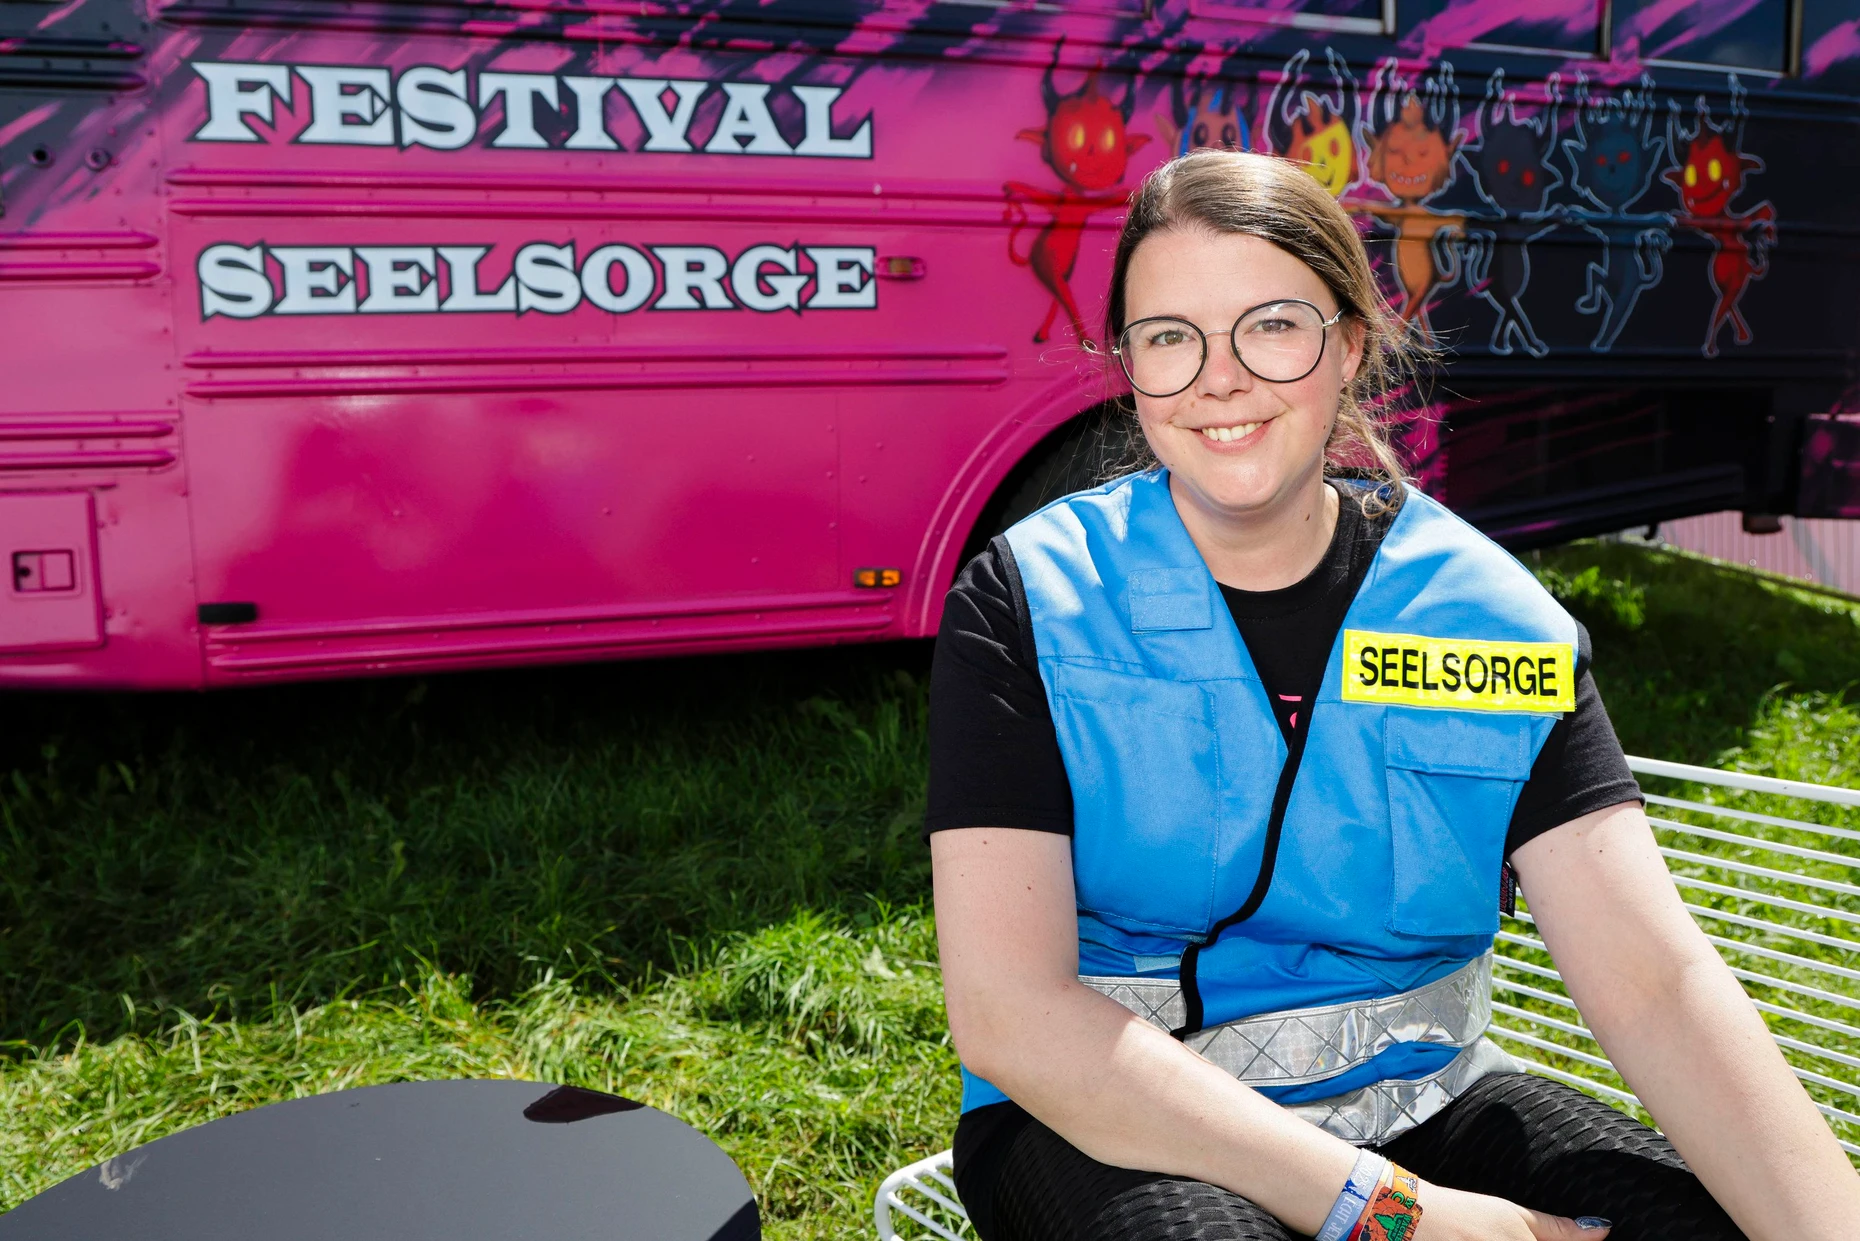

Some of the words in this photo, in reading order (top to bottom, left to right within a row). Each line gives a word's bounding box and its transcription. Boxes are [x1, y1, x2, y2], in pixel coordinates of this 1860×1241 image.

[191, 60, 874, 158] FESTIVAL
[198, 240, 878, 319] SEELSORGE
[1359, 645, 1558, 697] SEELSORGE
